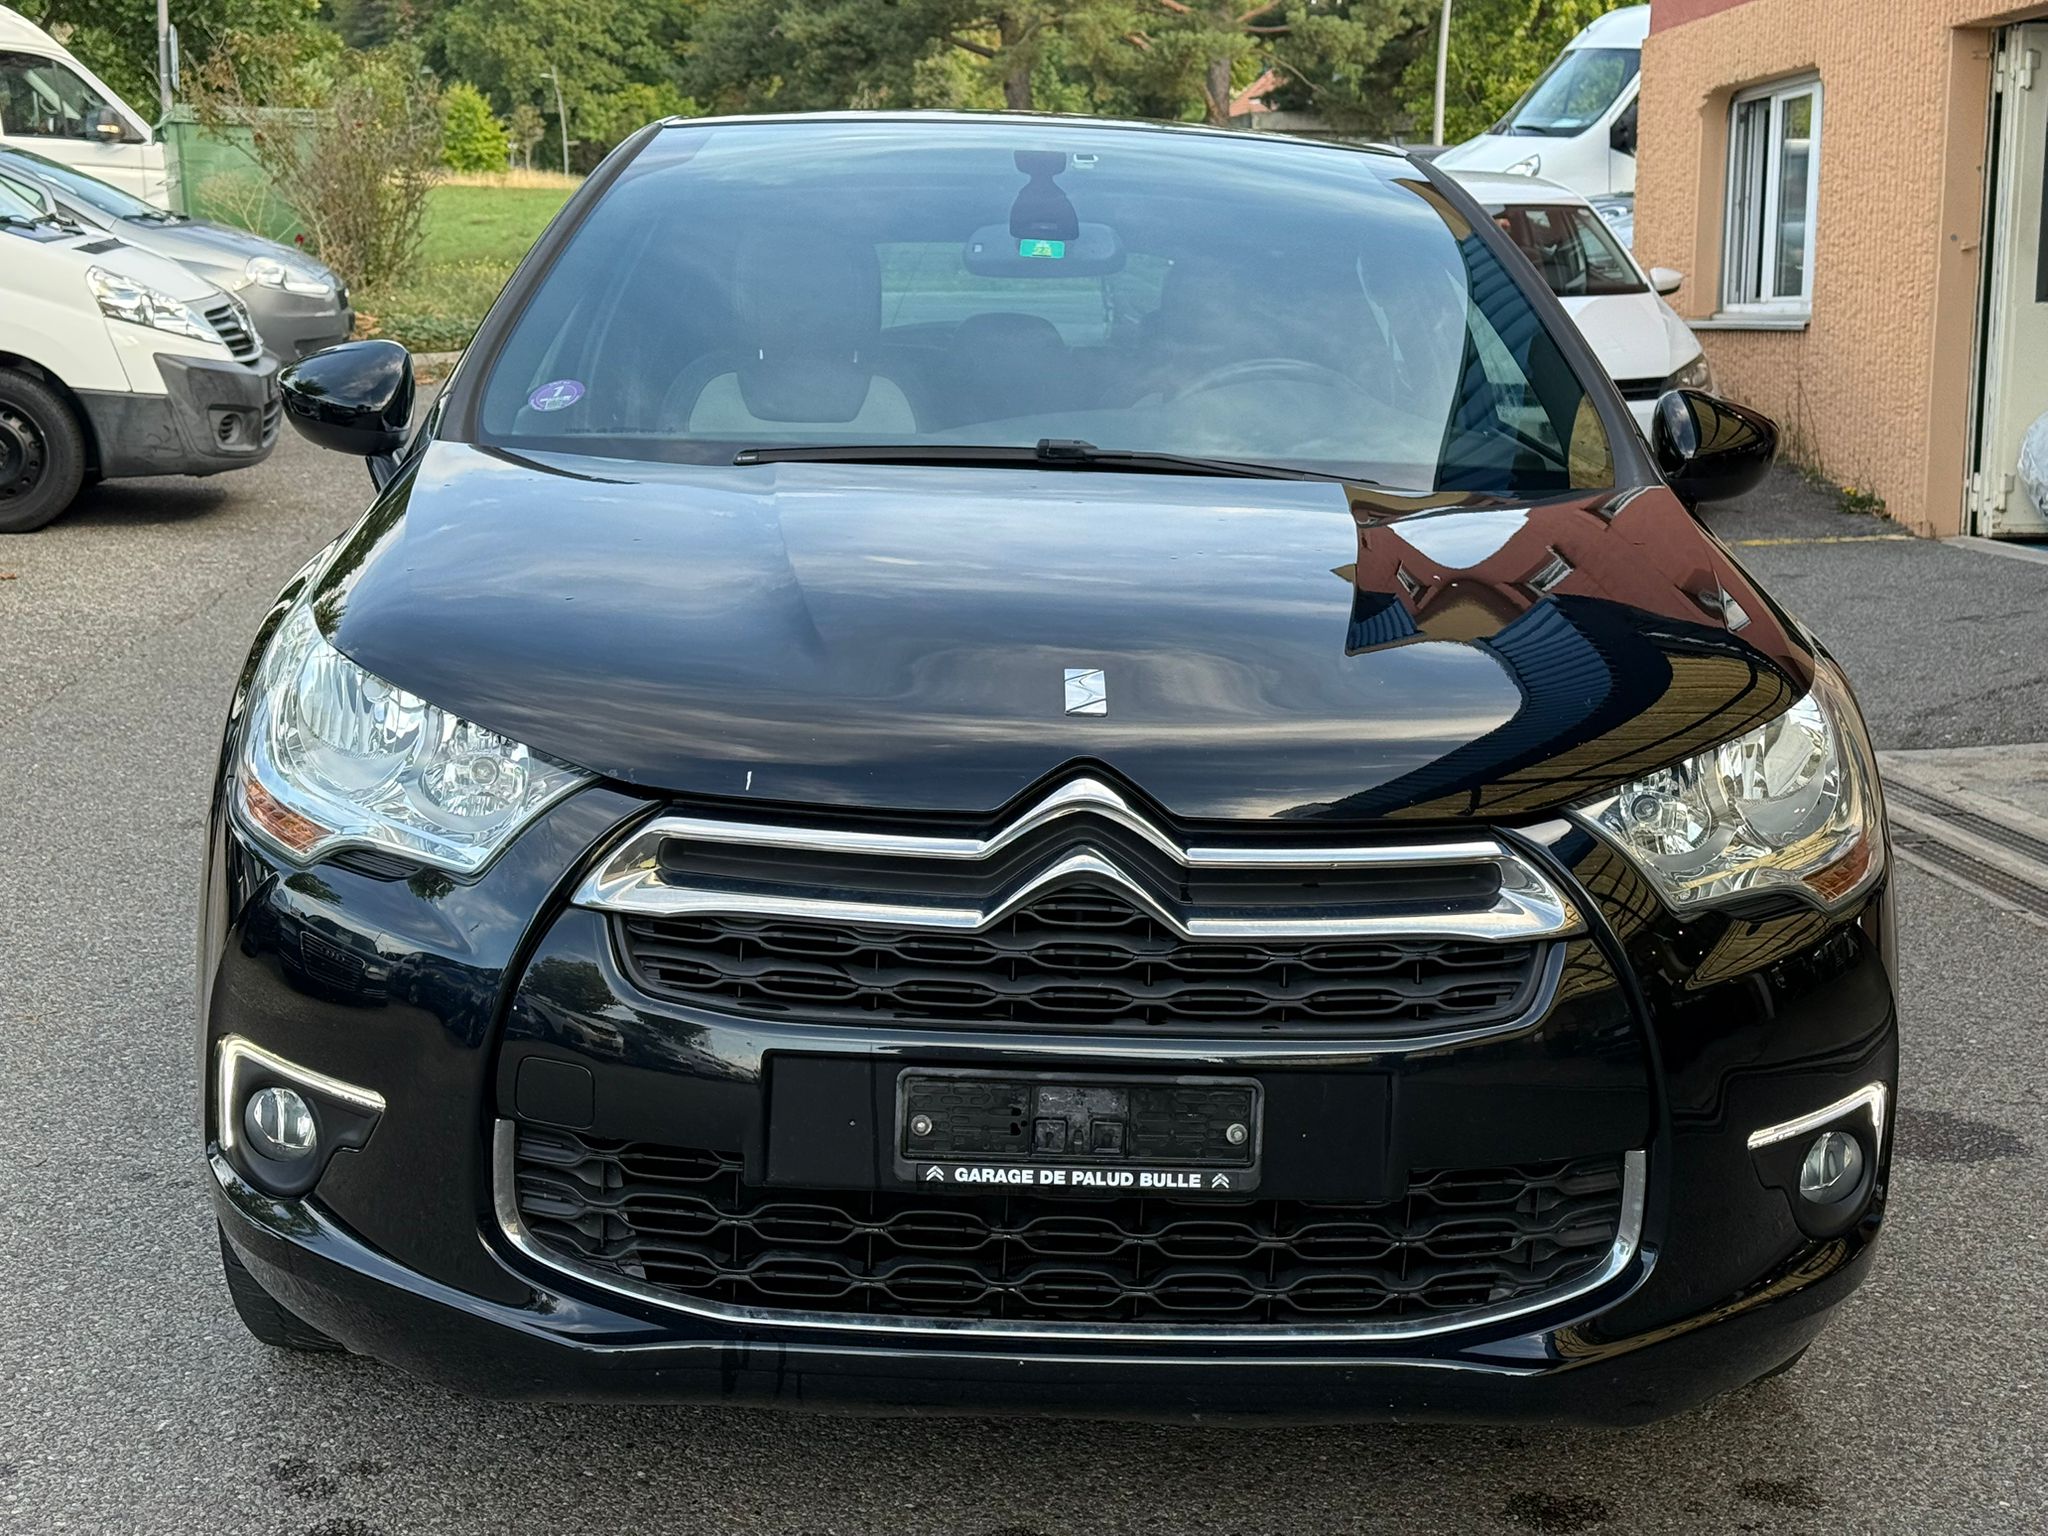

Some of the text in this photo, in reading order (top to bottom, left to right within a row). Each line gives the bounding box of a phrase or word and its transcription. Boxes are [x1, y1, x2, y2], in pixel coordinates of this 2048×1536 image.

[954, 1167, 1202, 1188] GARAGE DE PALUD BULLE
